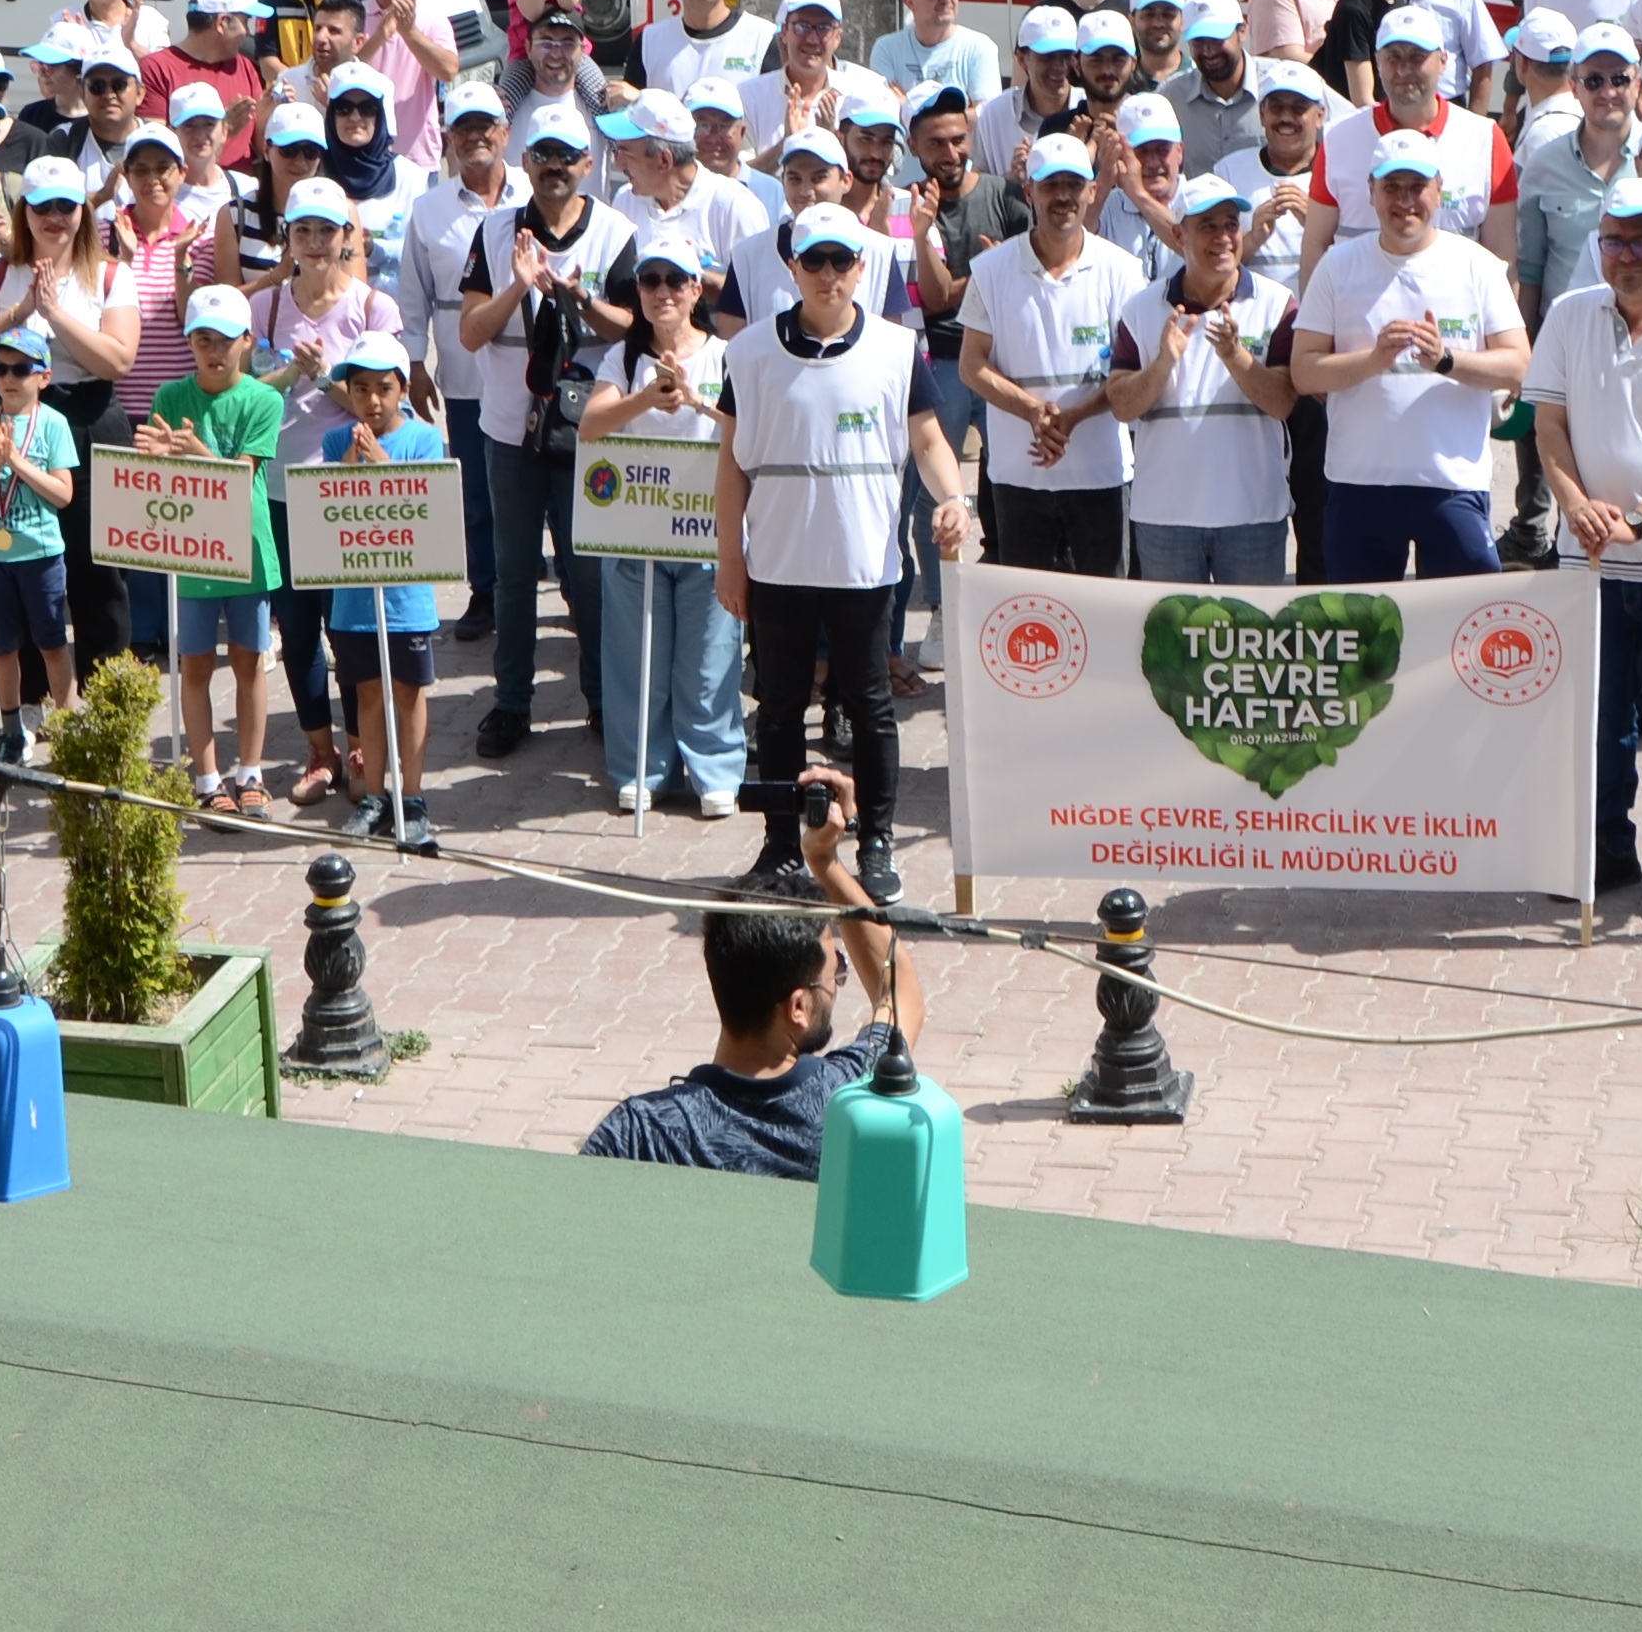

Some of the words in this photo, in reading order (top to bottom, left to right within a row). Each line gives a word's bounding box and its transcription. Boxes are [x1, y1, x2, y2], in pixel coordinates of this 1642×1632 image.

[113, 467, 162, 494] HER
[171, 475, 228, 501] ATIK
[319, 479, 373, 499] SIFIR
[379, 478, 429, 496] ATIK
[625, 465, 671, 485] SIFIR
[145, 495, 195, 528] ÇÖP
[323, 498, 429, 523] GELECEĞE
[624, 485, 670, 507] ATIK
[107, 525, 234, 563] DEĞİLDİR.
[339, 523, 415, 547] DEĞER
[341, 550, 414, 569] KATTIK
[1181, 620, 1360, 662] TÜRKİYE
[1202, 662, 1340, 699] ÇEVRE
[1185, 695, 1358, 730] HAFTASI
[1229, 733, 1261, 746] 01-07
[1263, 730, 1318, 745] HAZİRAN
[1050, 803, 1134, 827] NİĞDE
[1139, 806, 1229, 834] ÇEVRE,
[1234, 806, 1377, 836] ŞEHİRCİLİK
[1382, 817, 1417, 836] VE
[1423, 812, 1498, 838] İKLİM
[1090, 840, 1245, 873] DEĞİŞİKLİĞİ
[1281, 847, 1458, 876] MÜDÜRLÜĞÜ
